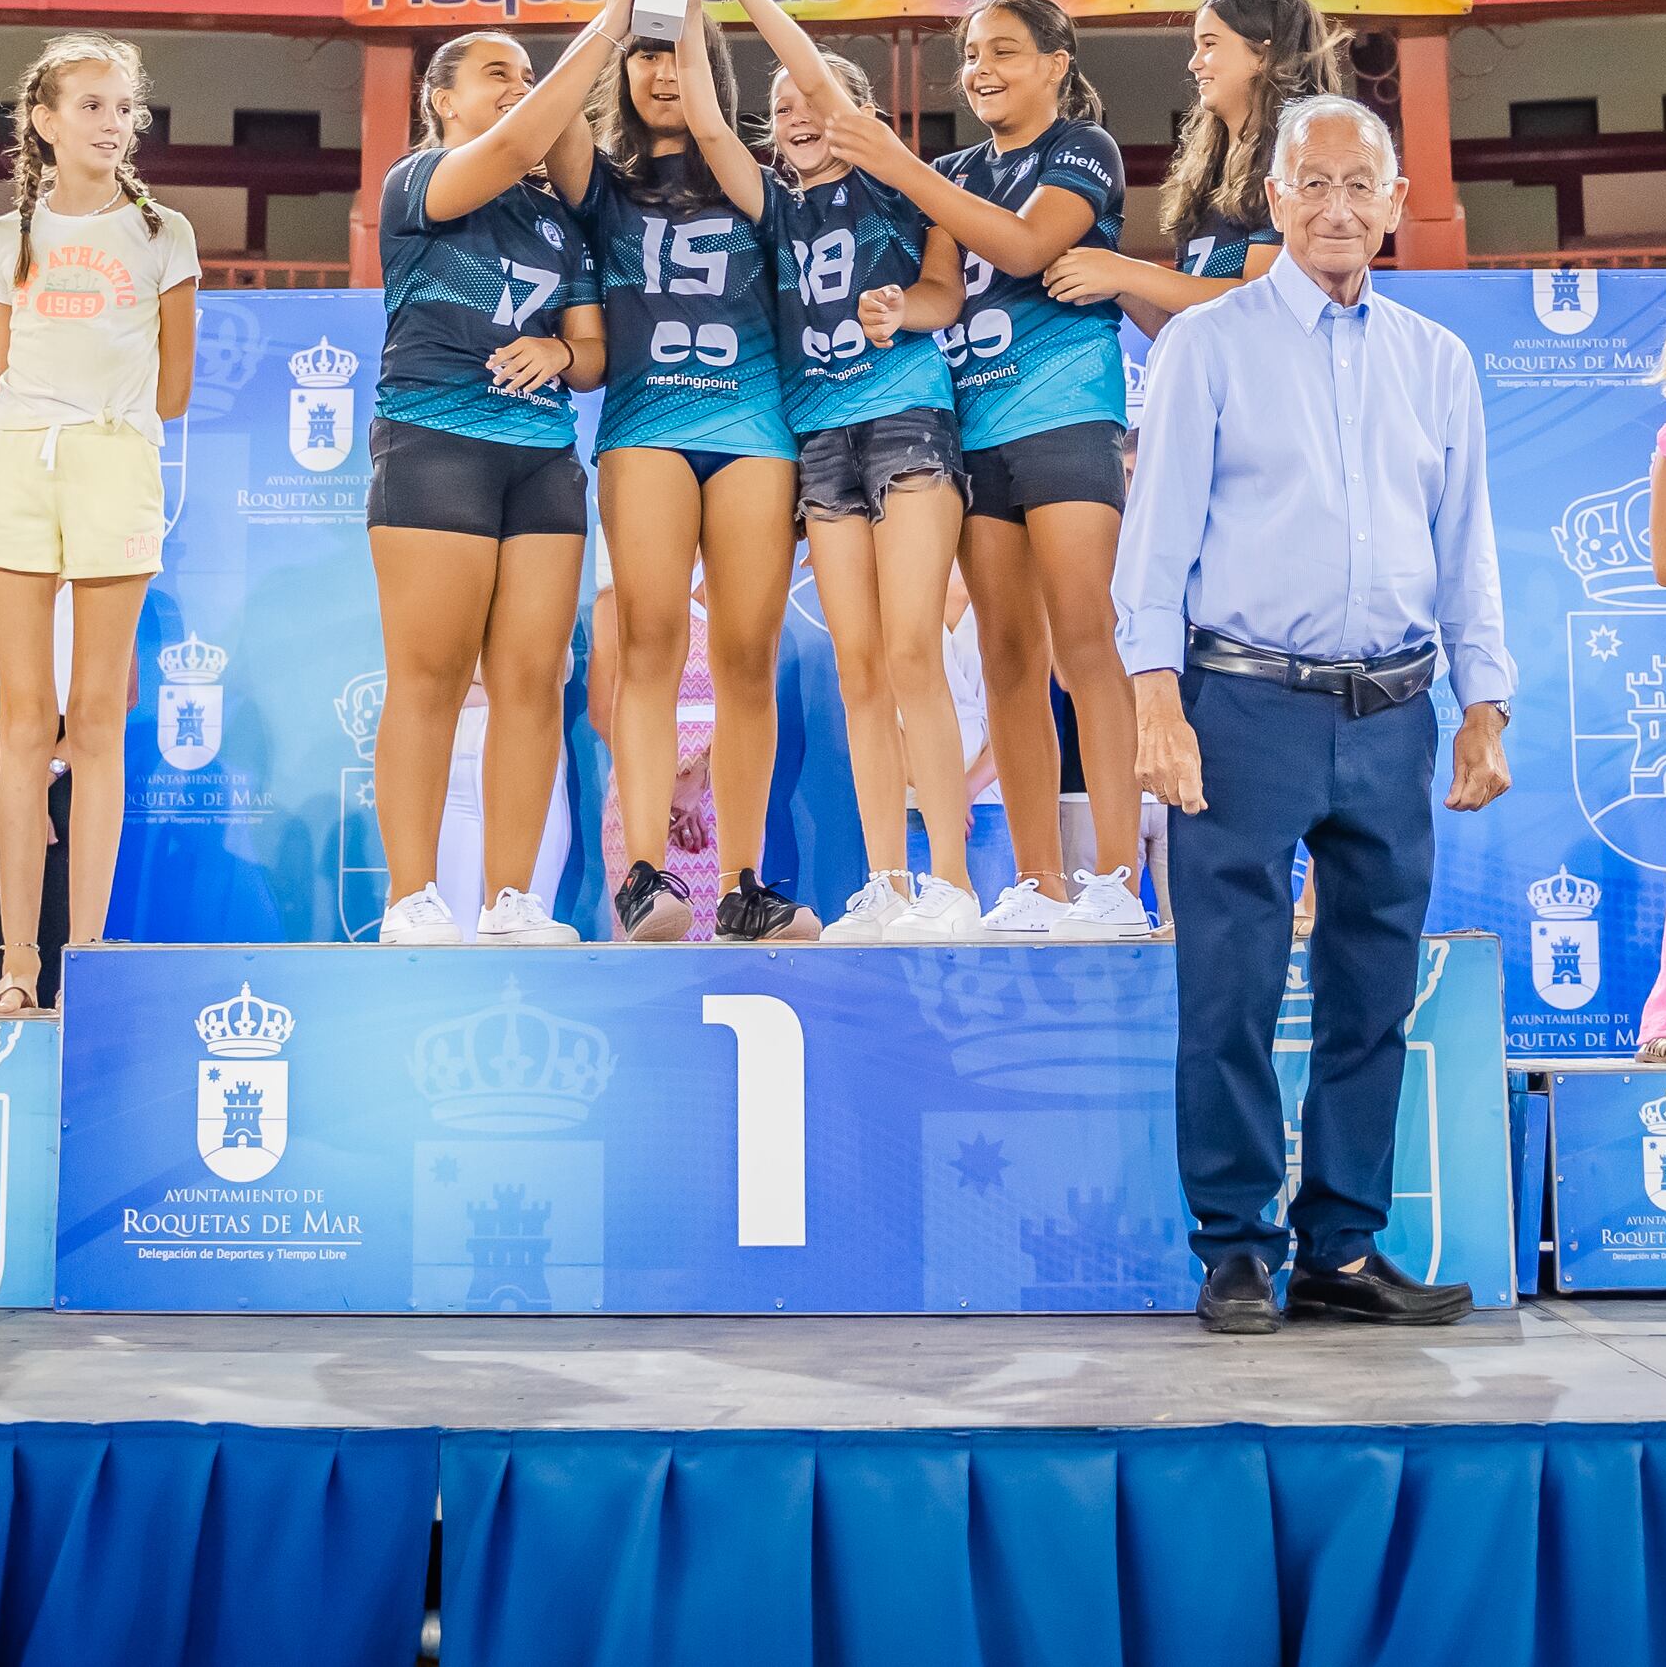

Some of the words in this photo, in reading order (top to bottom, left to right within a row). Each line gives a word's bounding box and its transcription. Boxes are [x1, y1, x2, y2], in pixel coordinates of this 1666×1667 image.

[641, 215, 734, 297] 15
[47, 245, 138, 310] ATHLETIC
[44, 295, 97, 315] 1969
[1513, 337, 1609, 350] AYUNTAMIENTO
[1612, 337, 1628, 349] DE
[1484, 352, 1577, 373] ROQUETAS
[1583, 355, 1606, 370] DE
[1613, 351, 1656, 370] MAR
[646, 373, 739, 391] meetingpoint
[265, 475, 360, 486] AYUNTAMIENTO
[236, 489, 327, 510] ROQUETAS
[334, 492, 355, 507] DE
[134, 774, 229, 785] AYUNTAMIENTO
[232, 774, 247, 784] DE
[203, 792, 224, 807] DE
[232, 789, 274, 807] MAR
[1510, 1013, 1611, 1025] AYUNTAMIENTO
[1614, 1013, 1630, 1024] DE
[1584, 1032, 1607, 1047] DE
[702, 993, 806, 1247] 1
[163, 1189, 298, 1203] AYUNTAMIENTO
[303, 1189, 325, 1203] DE
[122, 1208, 251, 1238] ROQUETAS
[261, 1214, 292, 1234] DE
[302, 1209, 364, 1234] MAR
[137, 1247, 198, 1262] Delegación
[199, 1248, 214, 1260] de
[216, 1248, 265, 1262] Deportes
[267, 1251, 275, 1262] y
[276, 1248, 317, 1262] Tiempo
[319, 1248, 347, 1260] Libre
